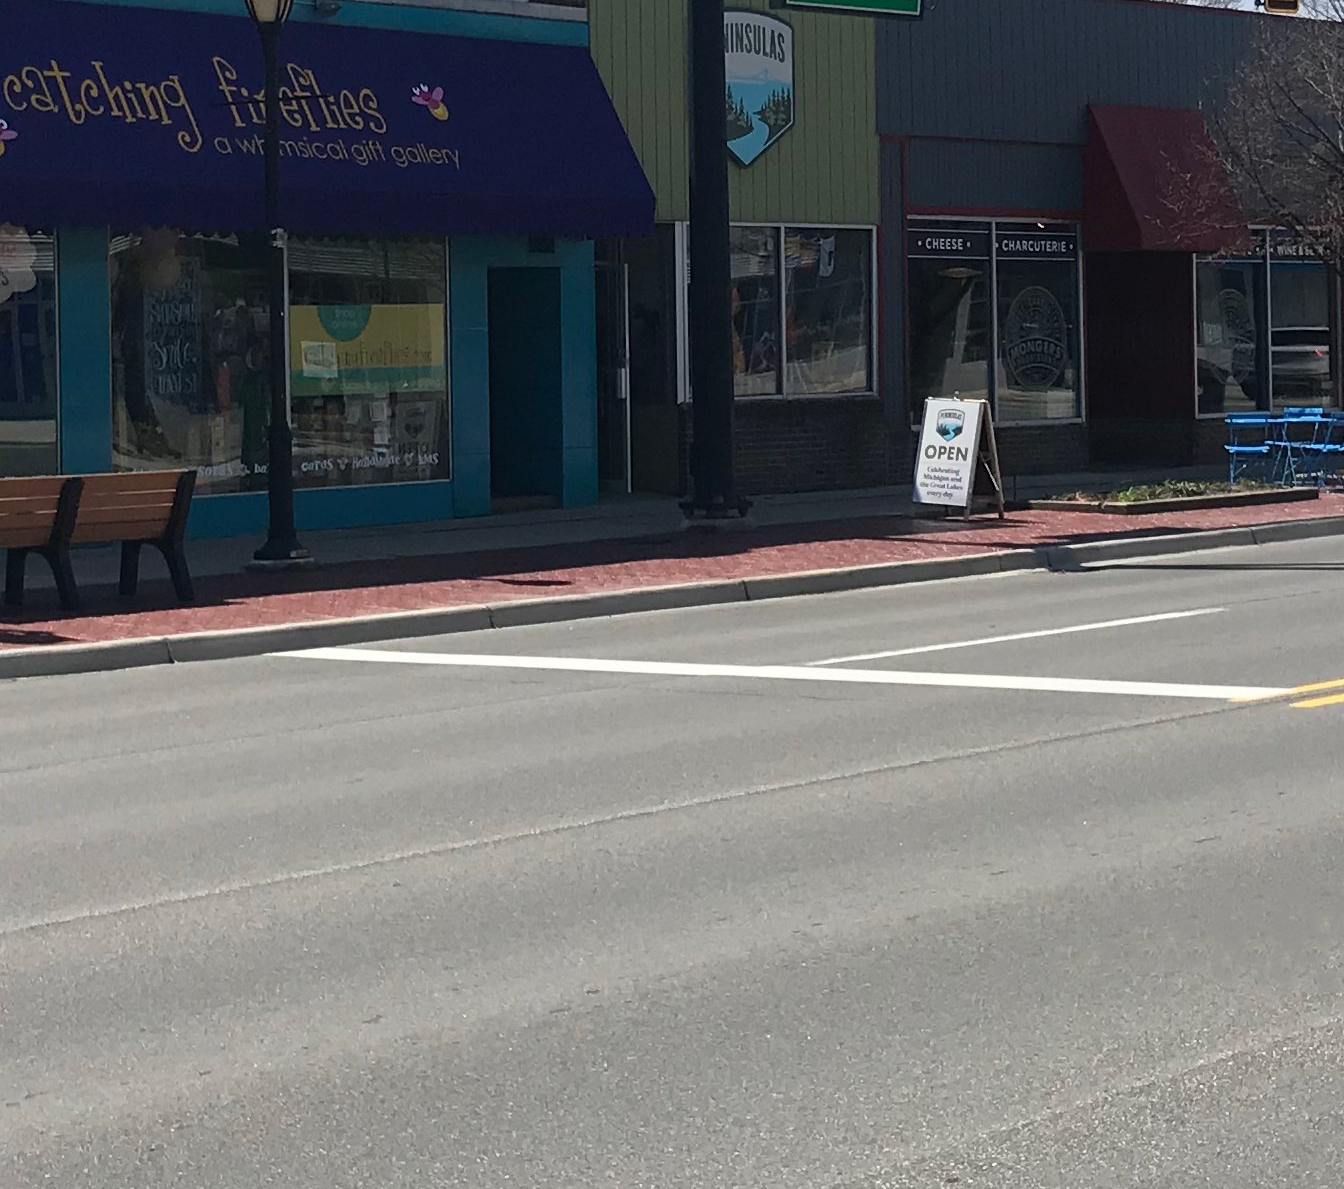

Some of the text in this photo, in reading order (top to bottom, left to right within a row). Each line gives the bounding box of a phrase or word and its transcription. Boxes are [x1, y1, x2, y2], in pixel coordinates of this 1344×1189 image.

[724, 23, 786, 63] INSULAS
[3, 59, 203, 153] catching
[214, 134, 460, 170] a whmsical gift gallery
[925, 237, 964, 250] CHEESE
[1002, 239, 1067, 252] CHARCUTERIE
[1010, 340, 1061, 360] MONGERS
[924, 445, 968, 462] OPEN
